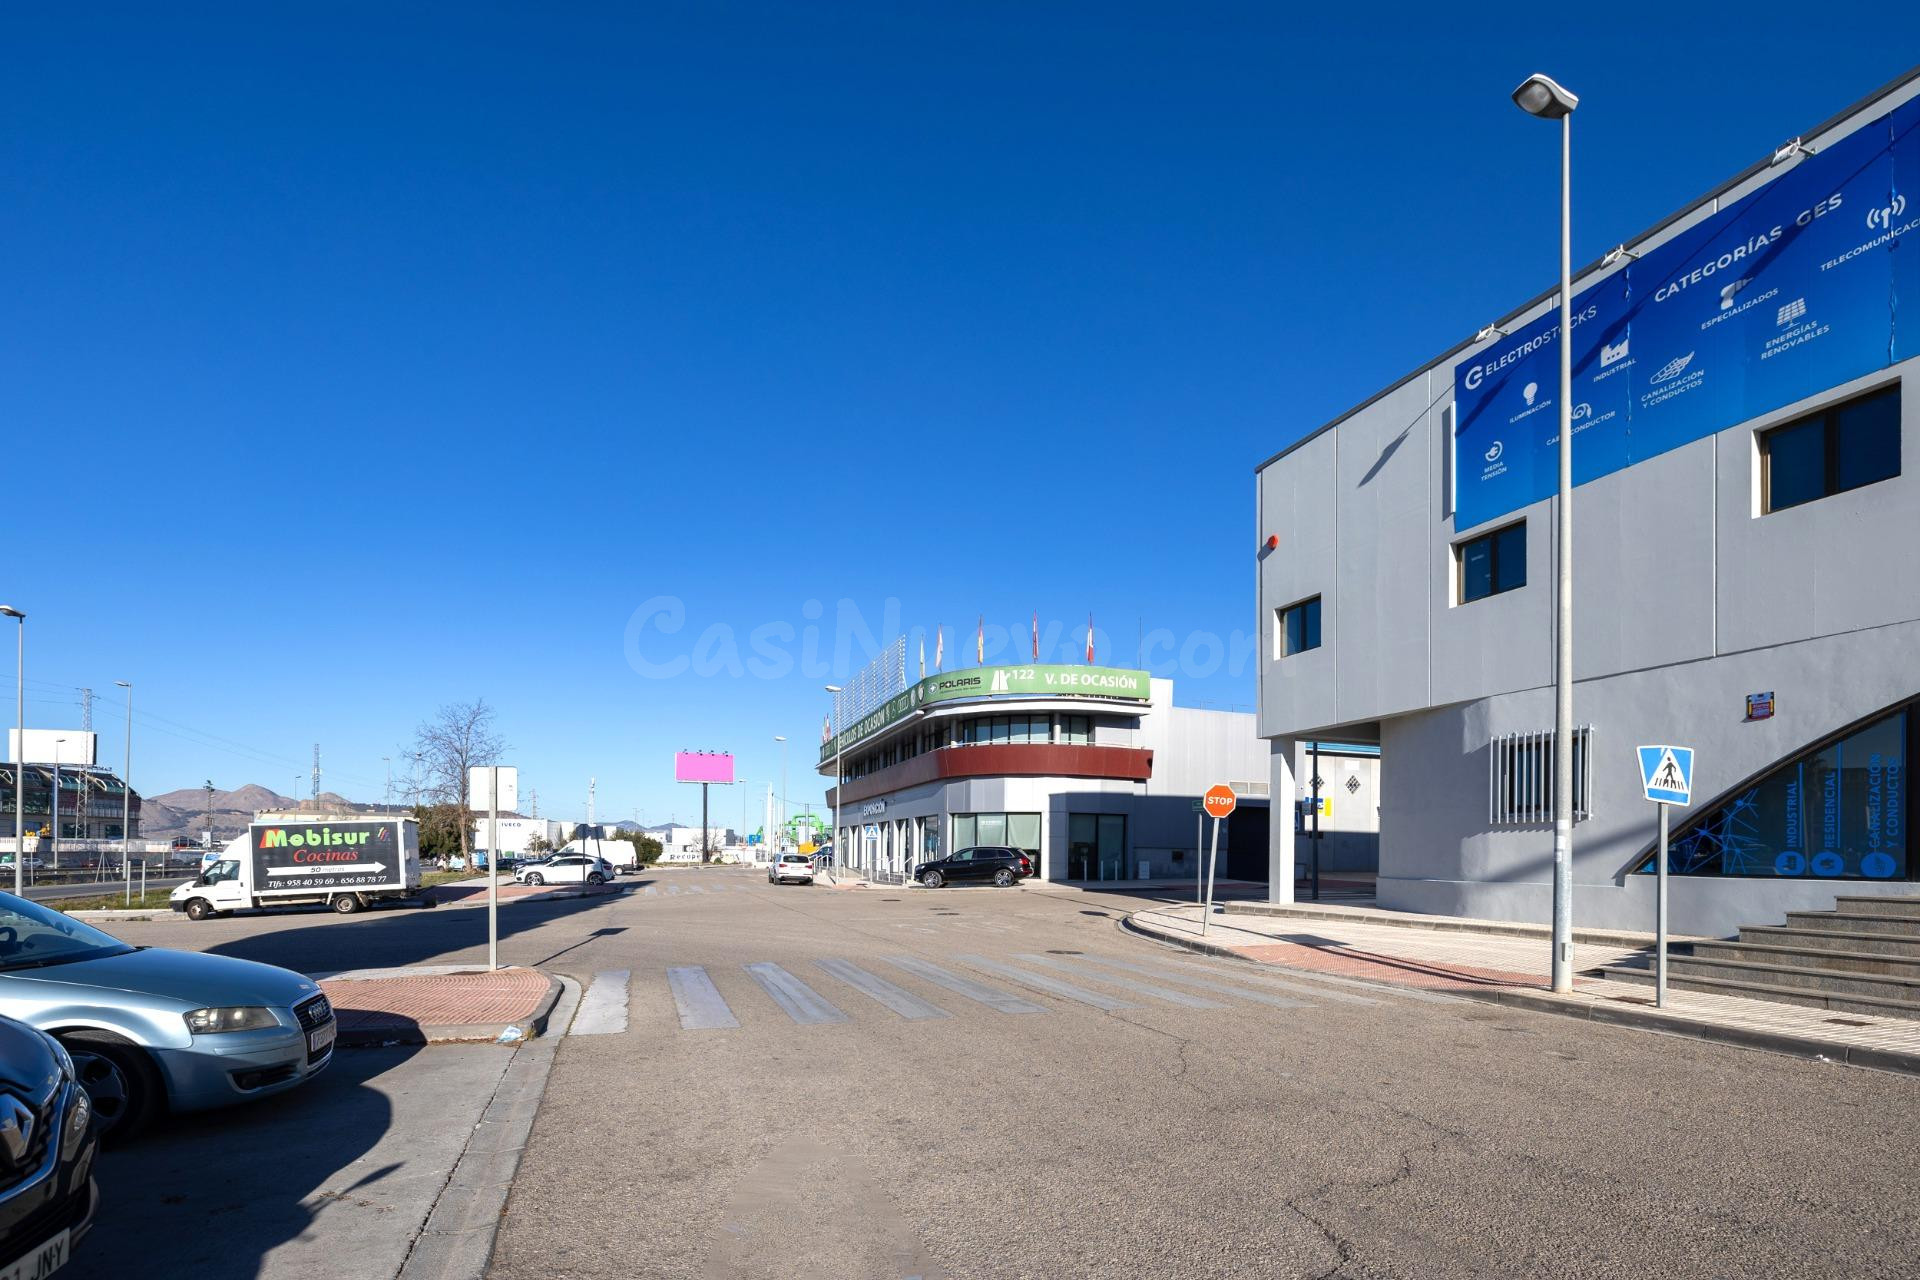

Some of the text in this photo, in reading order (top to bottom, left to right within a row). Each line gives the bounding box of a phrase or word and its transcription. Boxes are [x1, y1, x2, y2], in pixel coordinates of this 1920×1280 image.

[1654, 193, 1843, 302] CATEGORÍAS GES
[1701, 288, 1779, 330] ESPECIALIZADOS
[1486, 305, 1597, 376] ELECTROSTCKS
[1761, 325, 1830, 360] RENOVABLES
[1765, 320, 1818, 349] ENERGÍAS
[1593, 358, 1637, 383] INDUSTRIAL
[1641, 369, 1705, 402] CANALIZACIÓN
[1643, 378, 1703, 409] Y CONDUCTOS
[1509, 399, 1552, 424] ILUMINACIÓN
[1570, 410, 1616, 436] CONDUCTOR
[1484, 461, 1504, 474] MEDIA
[939, 676, 981, 690] POLARIS
[1012, 668, 1035, 680] 122
[1045, 673, 1138, 690] V. DE OCASIÓN
[857, 722, 864, 739] DE
[1207, 796, 1232, 805] STOP
[1887, 756, 1899, 837] CONDUCTOS
[1786, 780, 1798, 848] INDUSTRIAL
[1824, 771, 1835, 848] RESIDENCIAL
[260, 827, 370, 849] Mobisur
[293, 848, 359, 863] Cocinas
[287, 879, 301, 887] 958
[324, 877, 335, 885] 69
